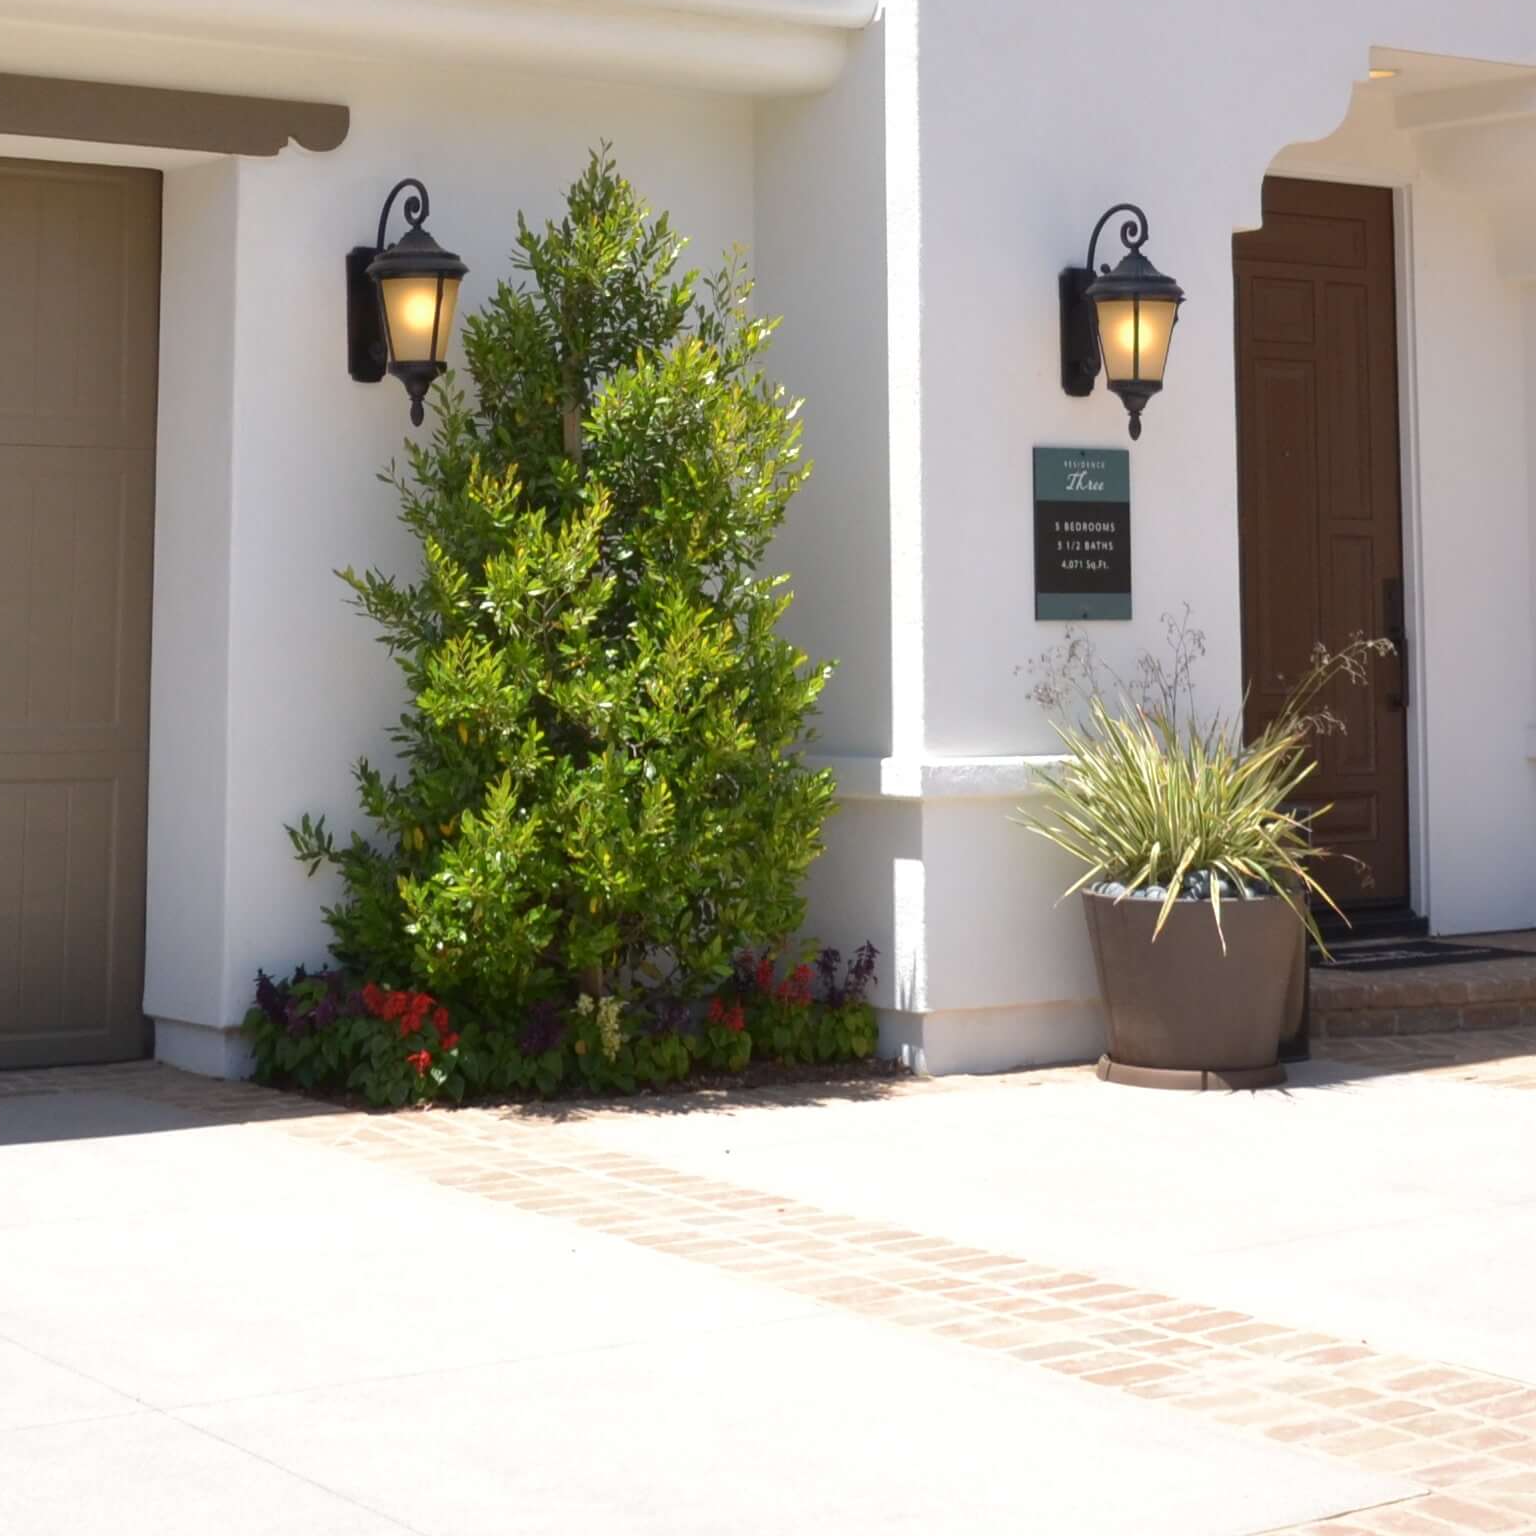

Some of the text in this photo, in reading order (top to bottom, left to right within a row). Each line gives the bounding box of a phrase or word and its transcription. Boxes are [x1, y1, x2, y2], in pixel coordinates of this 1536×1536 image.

[1065, 470, 1104, 491] Three
[1064, 521, 1115, 533] BEDROOMS
[1066, 540, 1080, 551] 1/2
[1084, 540, 1114, 551] BATHS
